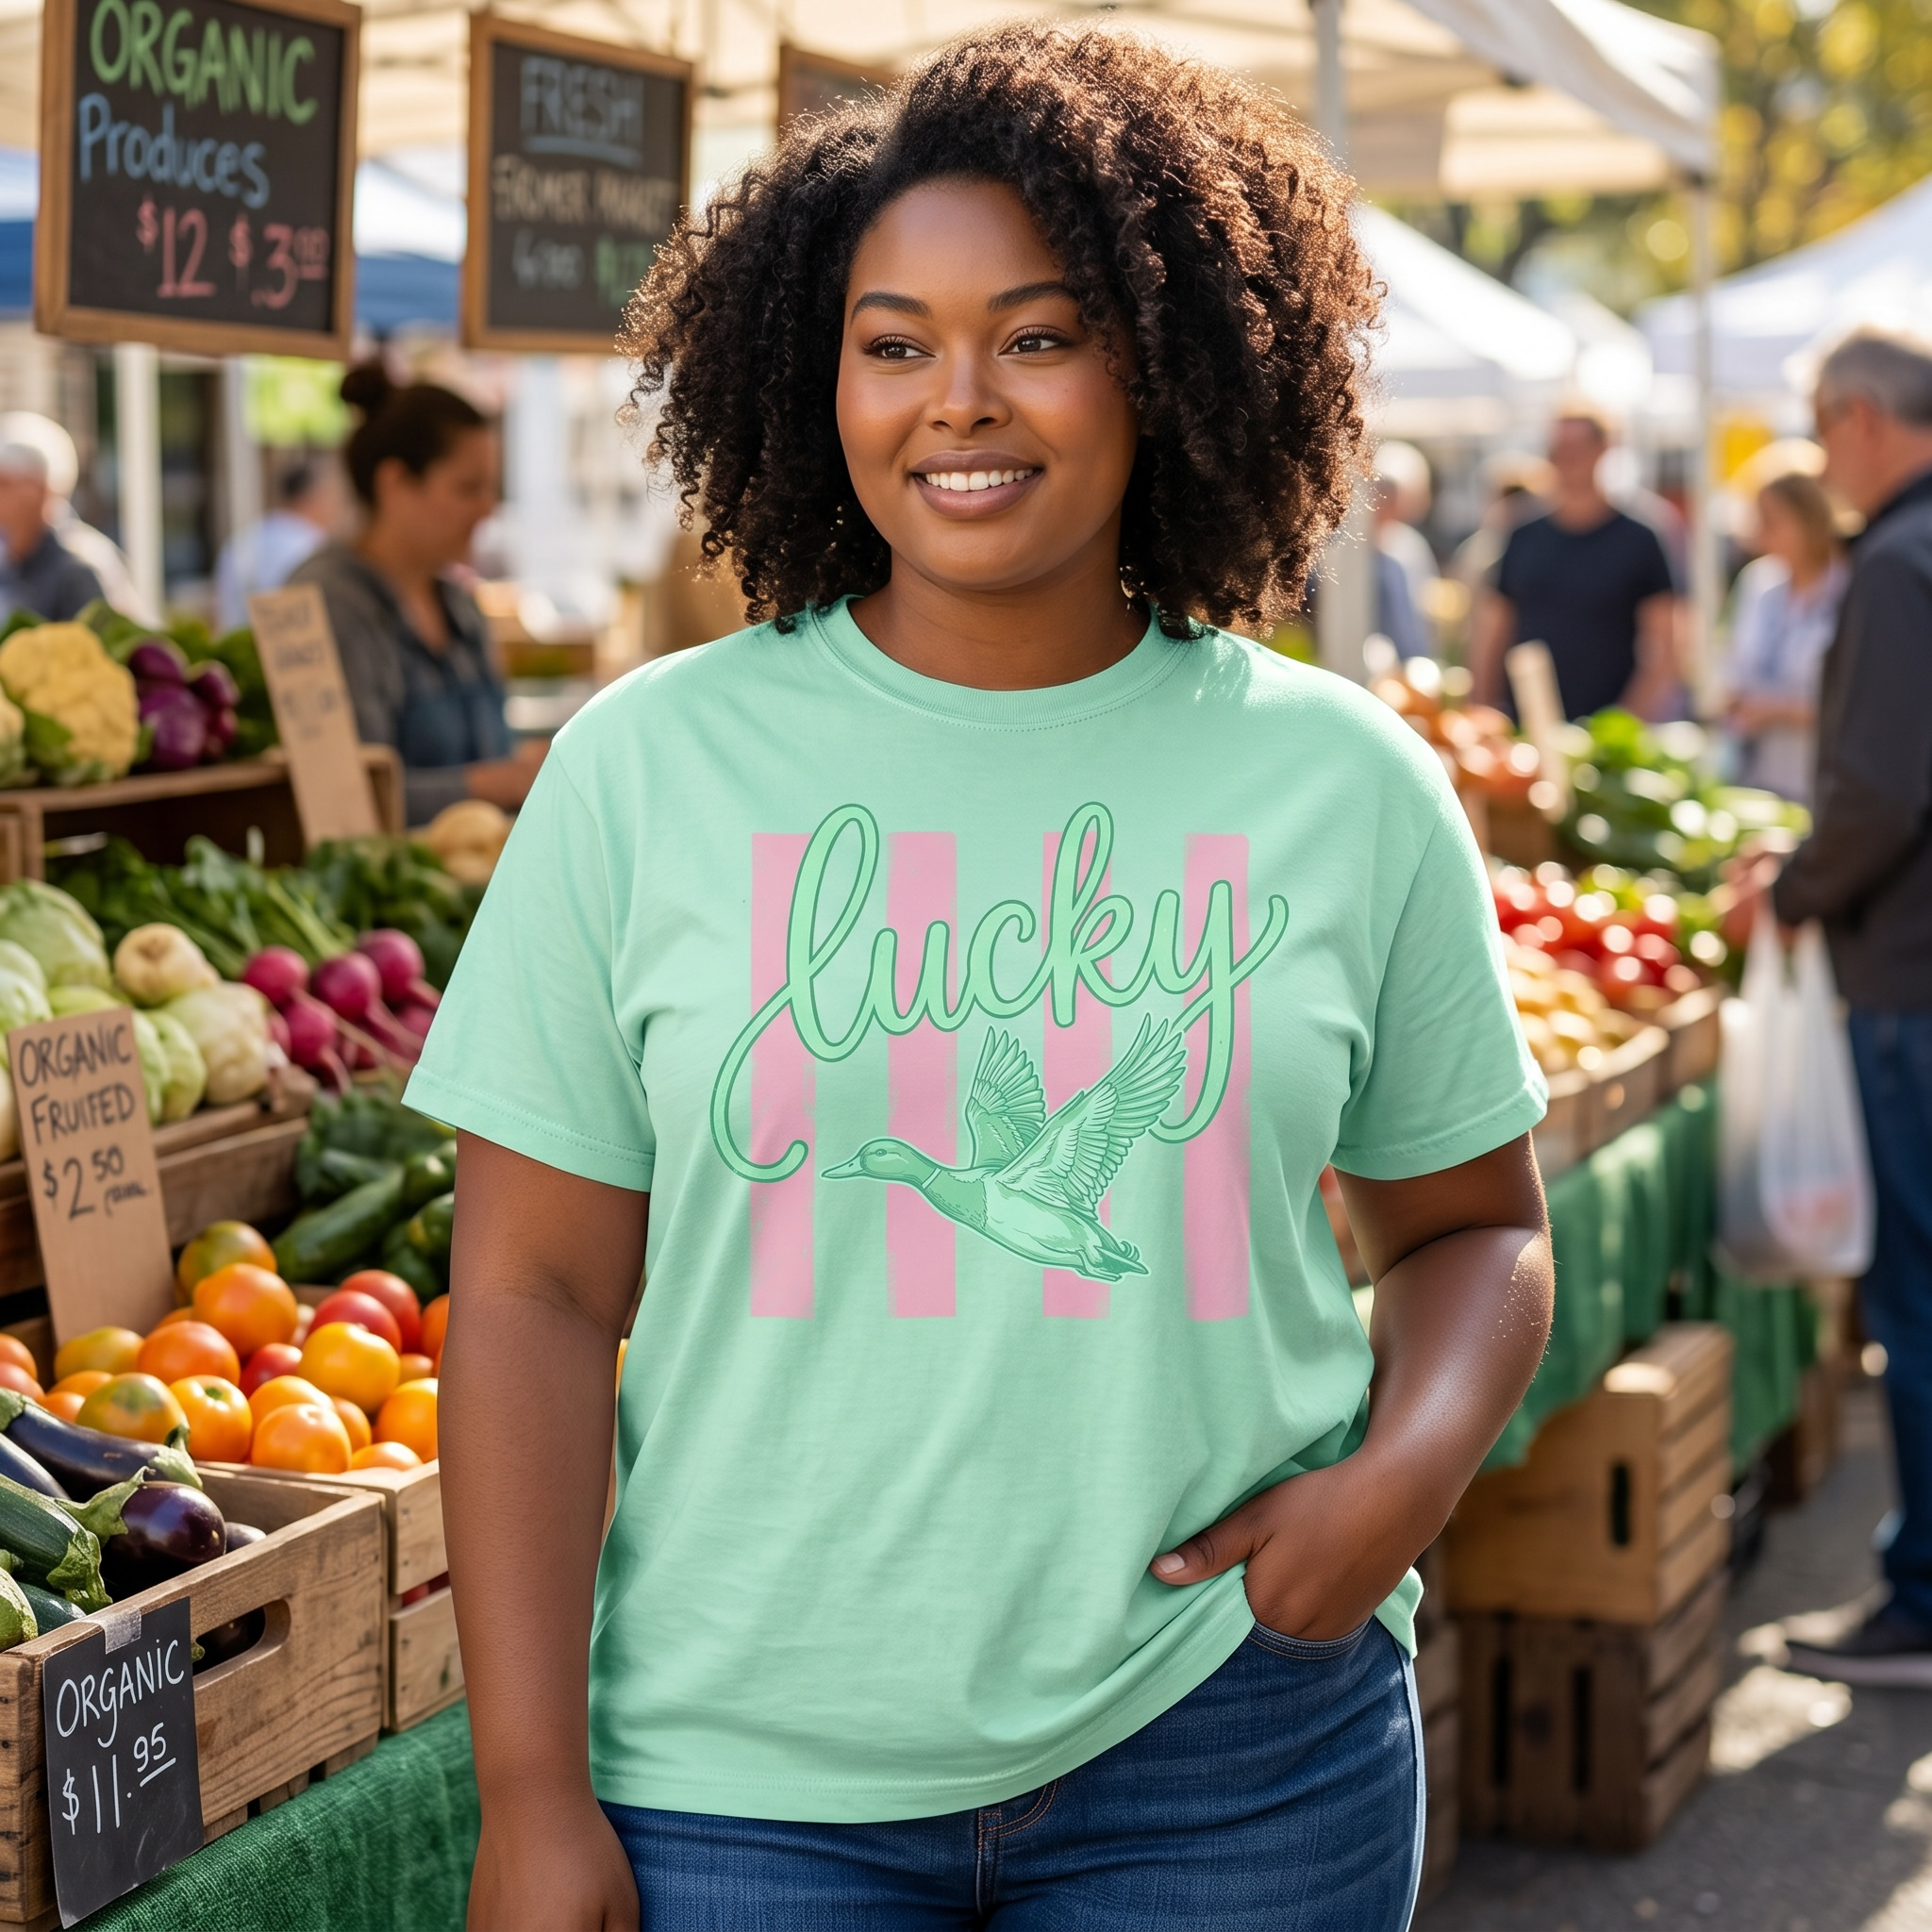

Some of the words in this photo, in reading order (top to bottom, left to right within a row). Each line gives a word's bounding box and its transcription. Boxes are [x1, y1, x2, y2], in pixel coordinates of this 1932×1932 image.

[90, 0, 319, 125] ORGANIC
[520, 56, 645, 139] FRESH
[78, 92, 271, 209] Produces
[136, 192, 217, 298] $12
[710, 802, 1290, 1184] lucky
[19, 1019, 132, 1088] ORGANIC
